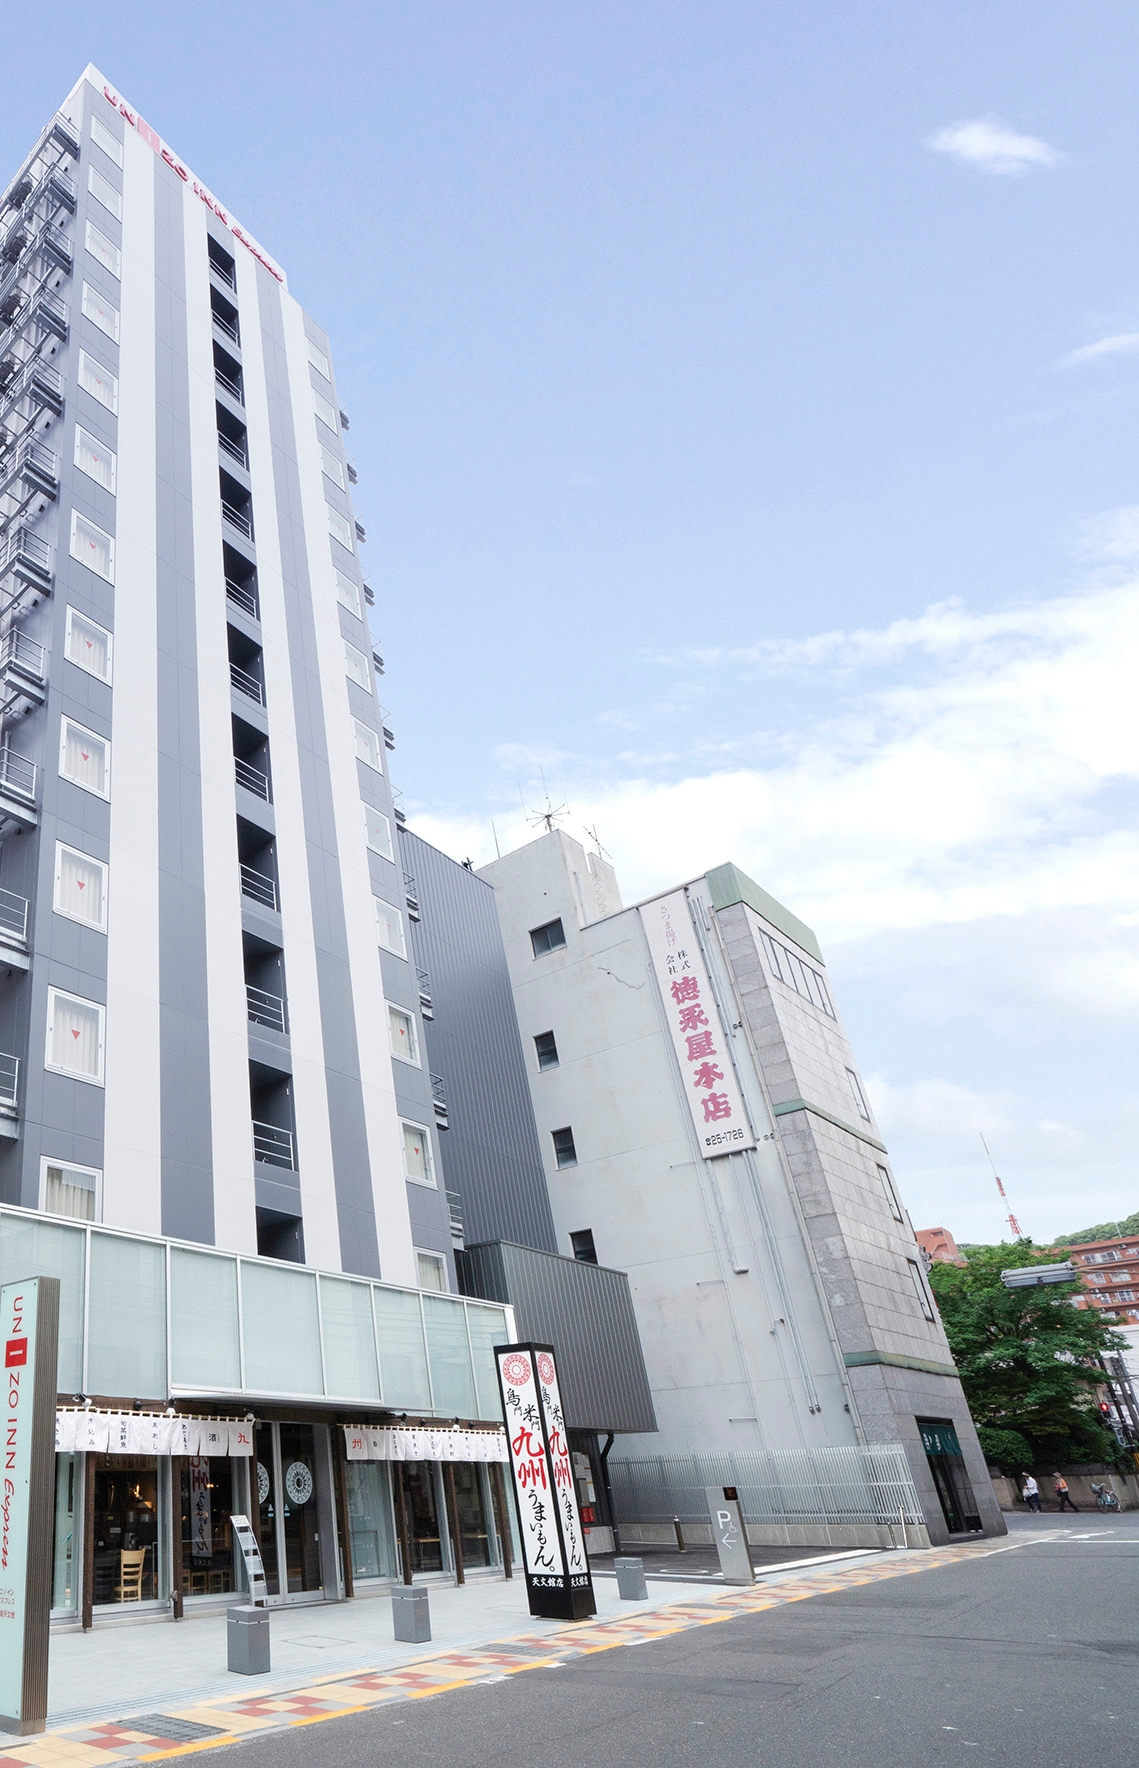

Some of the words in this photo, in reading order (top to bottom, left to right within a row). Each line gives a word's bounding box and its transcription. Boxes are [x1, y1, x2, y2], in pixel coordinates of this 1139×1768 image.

[103, 85, 189, 182] UNIZO
[192, 181, 228, 226] INN
[7, 1296, 26, 1409] UNIZO
[5, 1418, 18, 1469] INN
[208, 1433, 217, 1442] 酒
[352, 1438, 363, 1450] 州
[512, 1426, 547, 1490] 九州
[548, 1425, 572, 1489] 九州
[1, 1478, 15, 1570] Express
[716, 1510, 731, 1530] P
